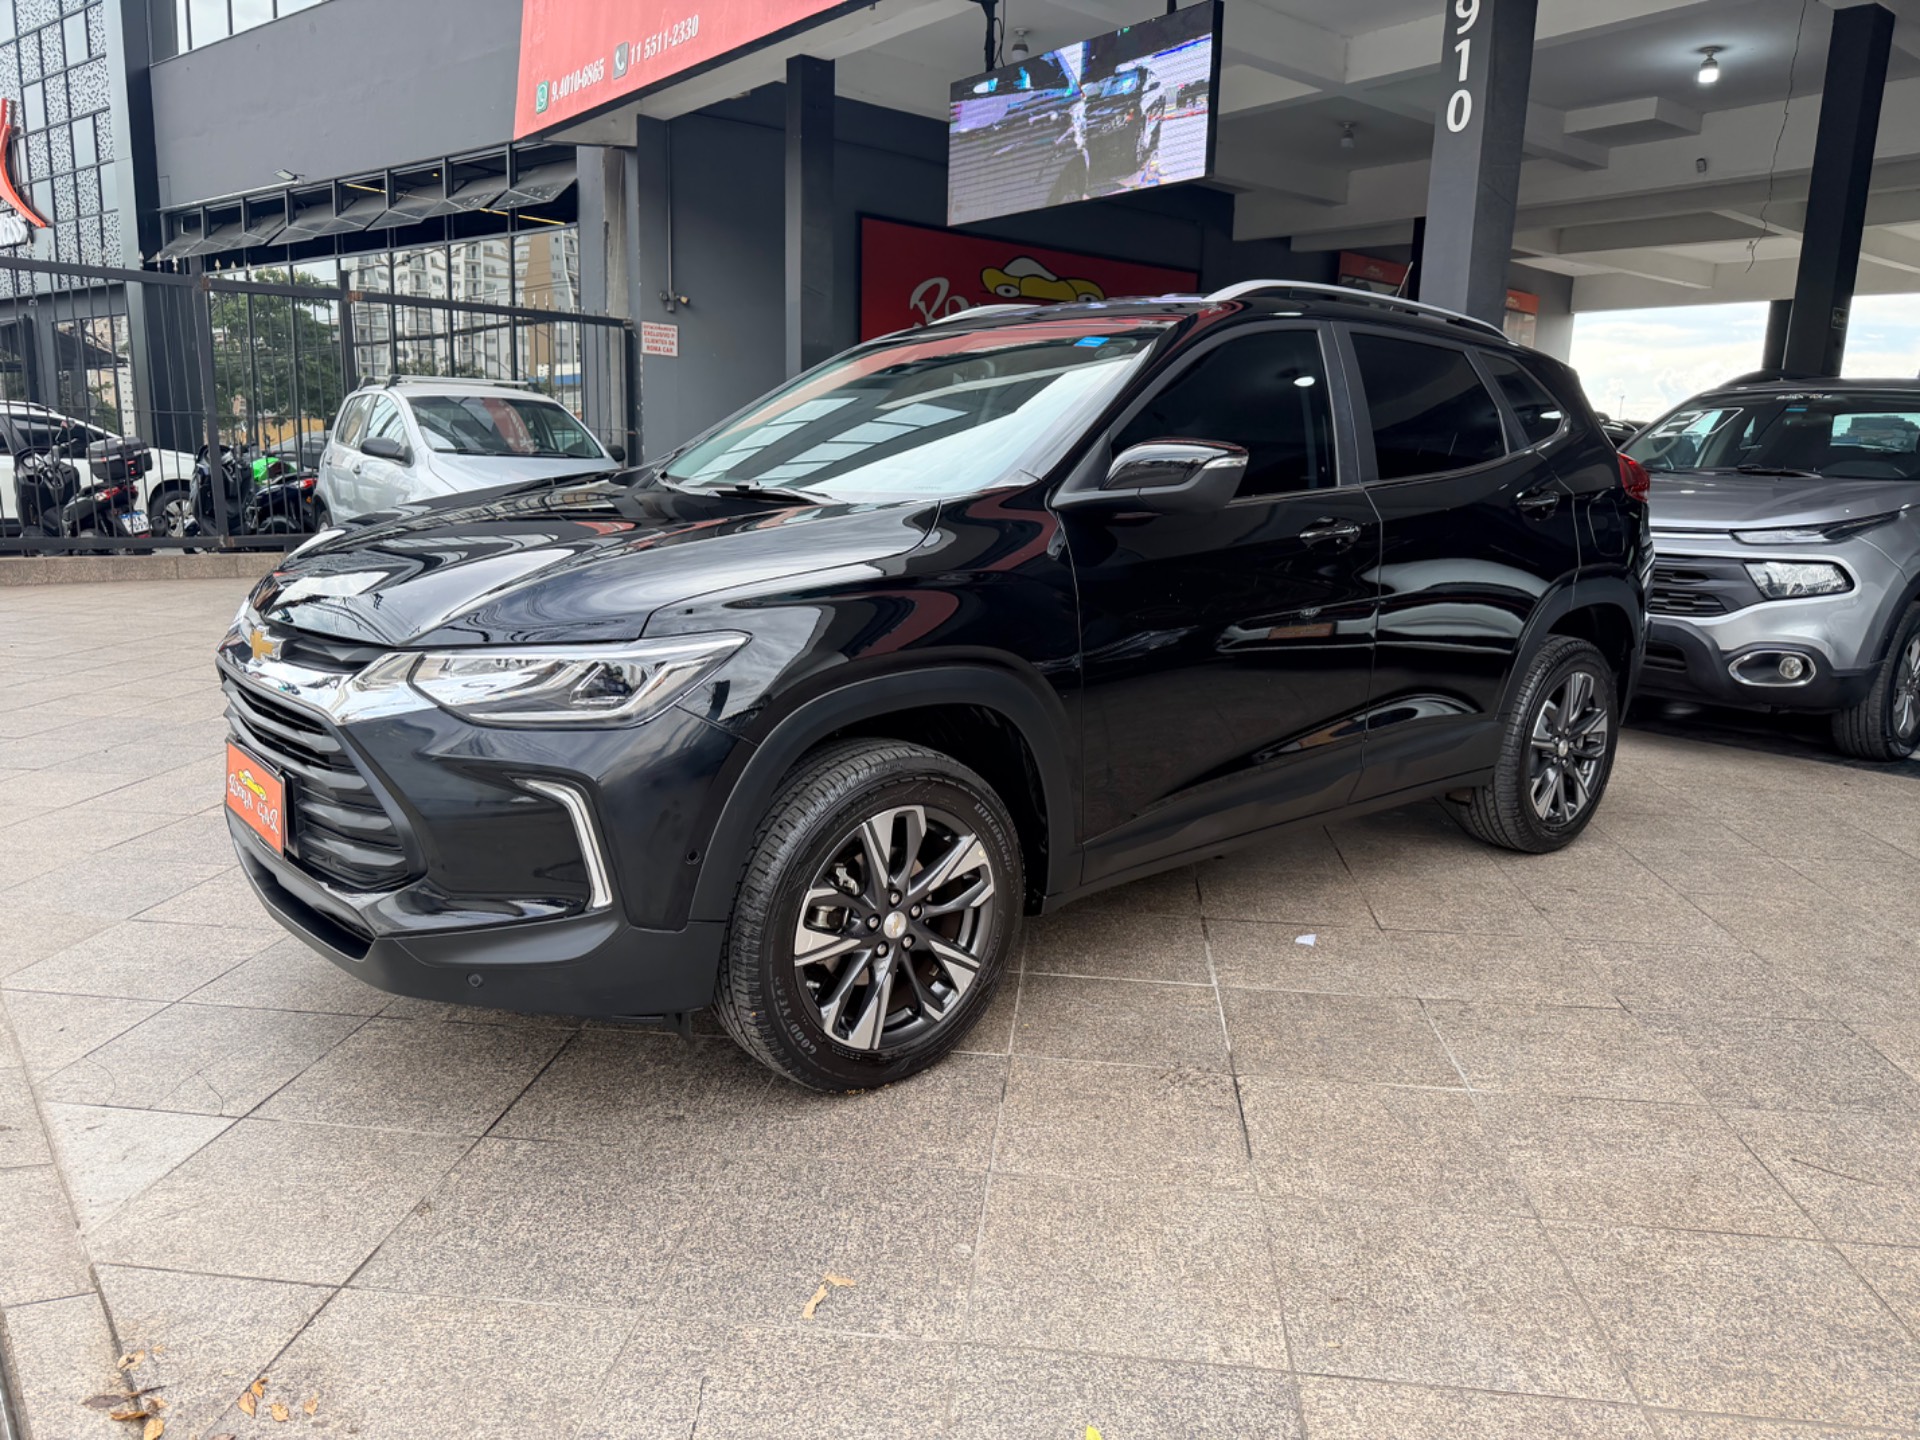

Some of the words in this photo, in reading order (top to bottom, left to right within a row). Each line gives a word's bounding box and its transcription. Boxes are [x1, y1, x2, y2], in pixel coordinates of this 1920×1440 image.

[631, 43, 641, 65] 11
[643, 14, 699, 59] 5511-2330
[1446, 0, 1480, 133] 910
